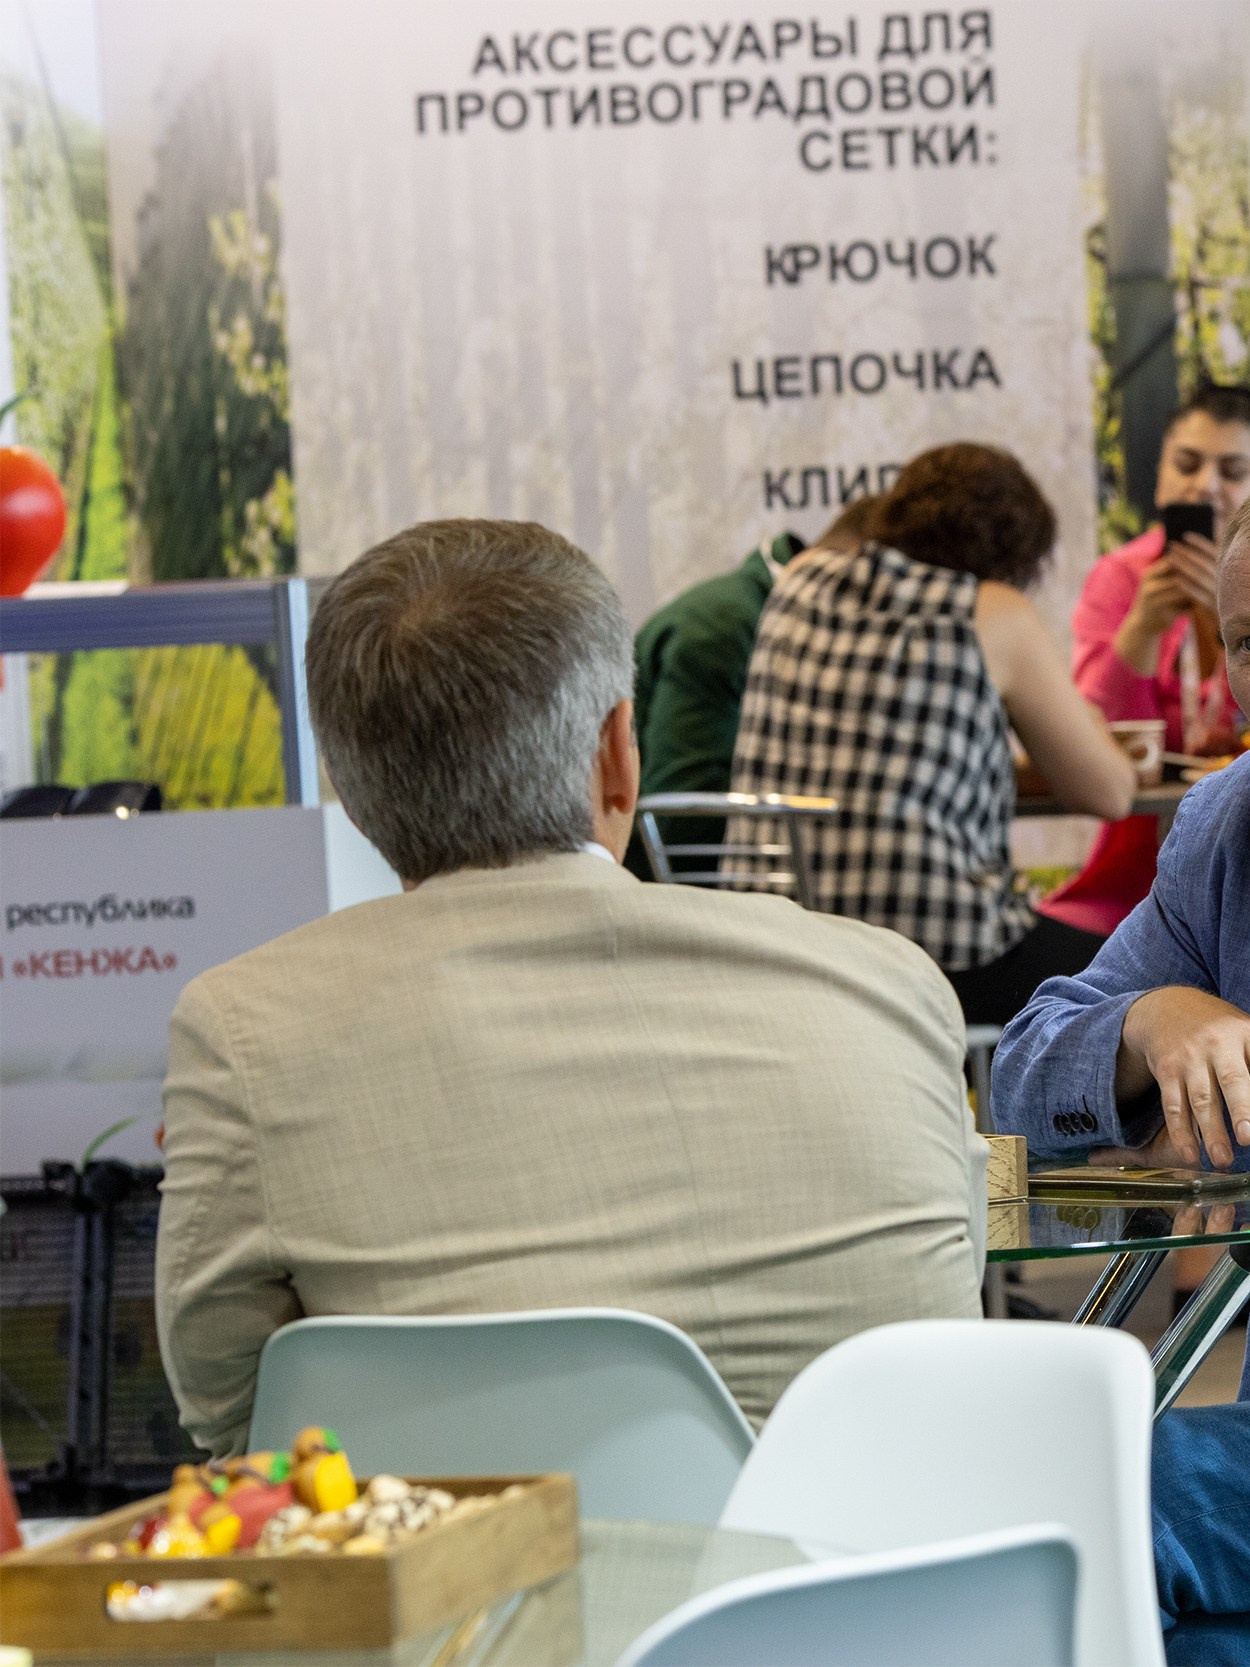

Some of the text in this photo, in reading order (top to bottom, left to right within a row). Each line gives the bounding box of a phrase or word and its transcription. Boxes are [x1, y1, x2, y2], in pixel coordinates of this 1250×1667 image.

[472, 10, 993, 76] АКСЕССУАРЫ ДЛЯ
[415, 57, 996, 135] ПРОТИВОГРАДОВОЙ
[799, 123, 998, 172] СЕТКИ:
[765, 235, 997, 287] КРЮЧОК
[731, 348, 1002, 405] ЦЕПОЧКА
[6, 894, 196, 932] республика
